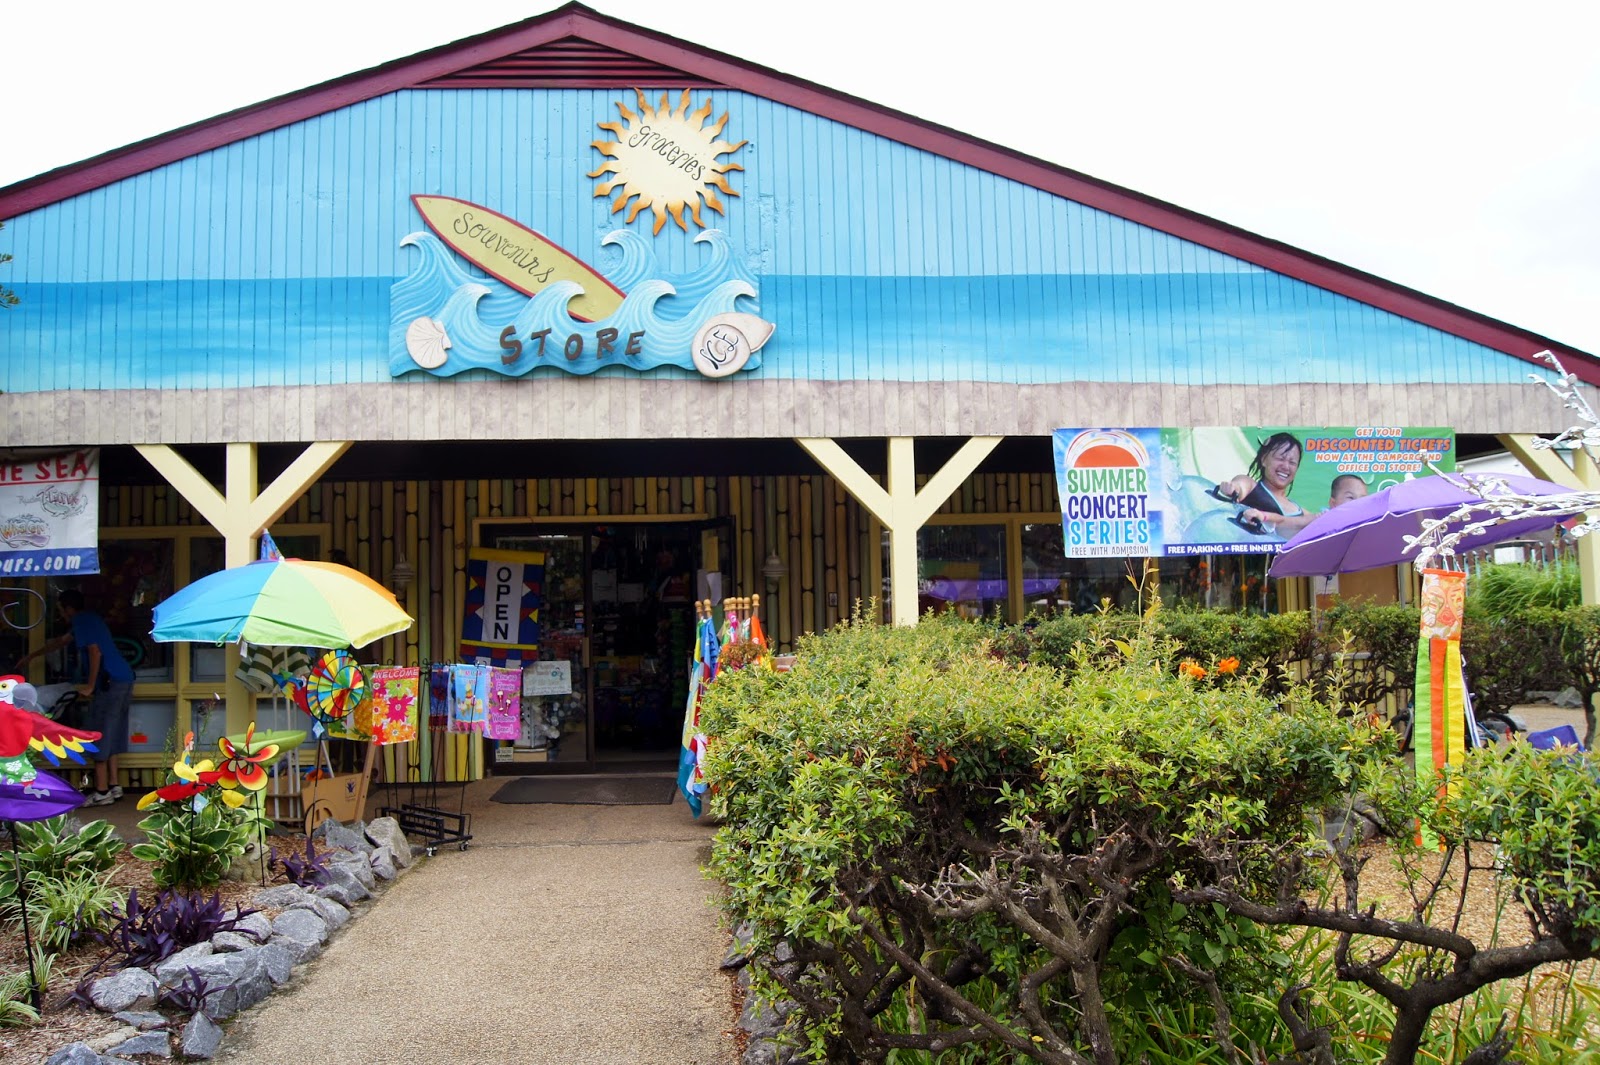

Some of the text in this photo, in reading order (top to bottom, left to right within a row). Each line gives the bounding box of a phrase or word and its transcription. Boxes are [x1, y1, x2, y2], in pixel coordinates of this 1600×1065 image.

[628, 125, 706, 181] groceries
[453, 212, 555, 284] Souvenirs
[499, 324, 646, 366] STORE
[699, 328, 739, 371] ICE
[1306, 438, 1451, 451] DISCOUNTED TICKETS
[1355, 427, 1402, 437] GET YOUR
[35, 452, 88, 480] SEA
[1316, 453, 1342, 462] NOW
[1342, 453, 1356, 462] AT
[1357, 452, 1375, 462] THE
[1337, 463, 1422, 472] OFFICE OR STORE!
[1067, 468, 1147, 494] SUMMER
[1068, 494, 1148, 520] CONCERT
[1070, 519, 1149, 545] SERIES
[1071, 545, 1149, 556] FREE WITH ADMISSION
[1167, 546, 1186, 554] FREE
[1187, 545, 1223, 553] PARKING
[1249, 544, 1274, 552] INNER
[0, 555, 81, 573] urs.com
[493, 566, 512, 640] OPEN
[373, 669, 418, 678] WELCOME
